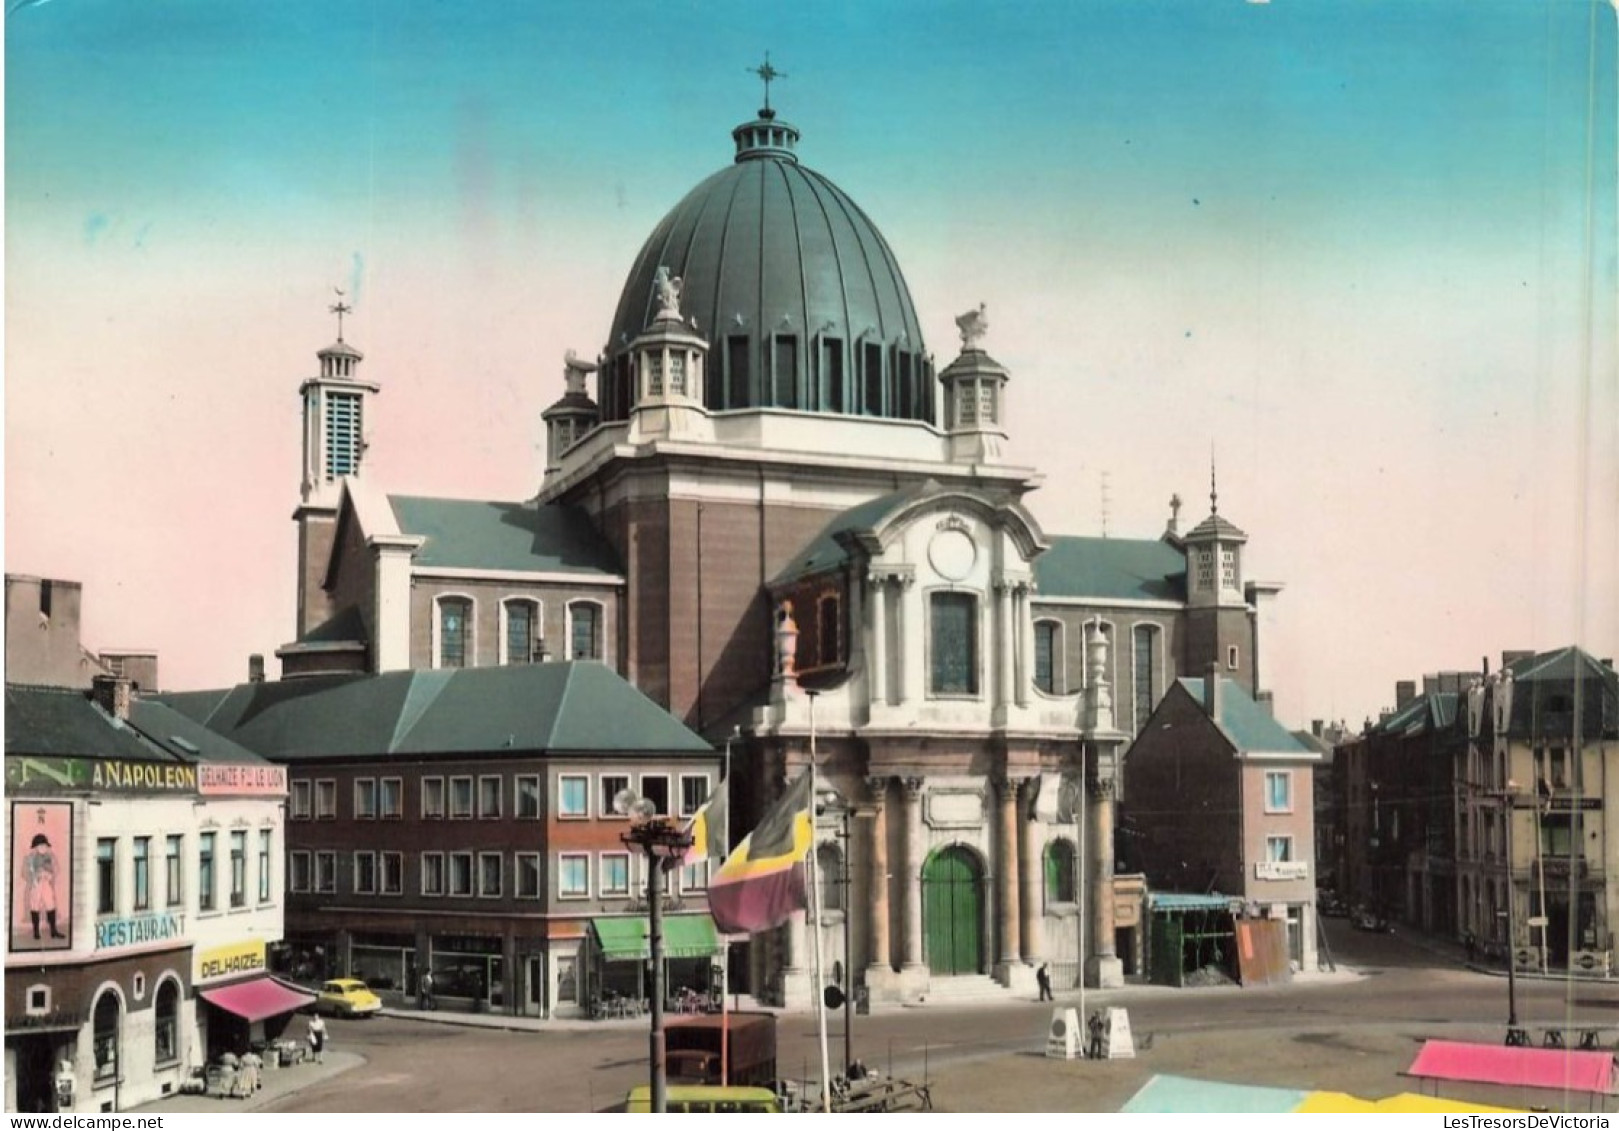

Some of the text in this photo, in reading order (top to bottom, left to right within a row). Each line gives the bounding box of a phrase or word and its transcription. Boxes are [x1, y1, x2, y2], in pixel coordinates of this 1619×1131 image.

[19, 758, 76, 787] N
[105, 760, 196, 789] NAPOLEON
[201, 766, 238, 787] DELHAIZE
[94, 914, 186, 951] RESTAURANT
[201, 952, 258, 979] DELHAIZE
